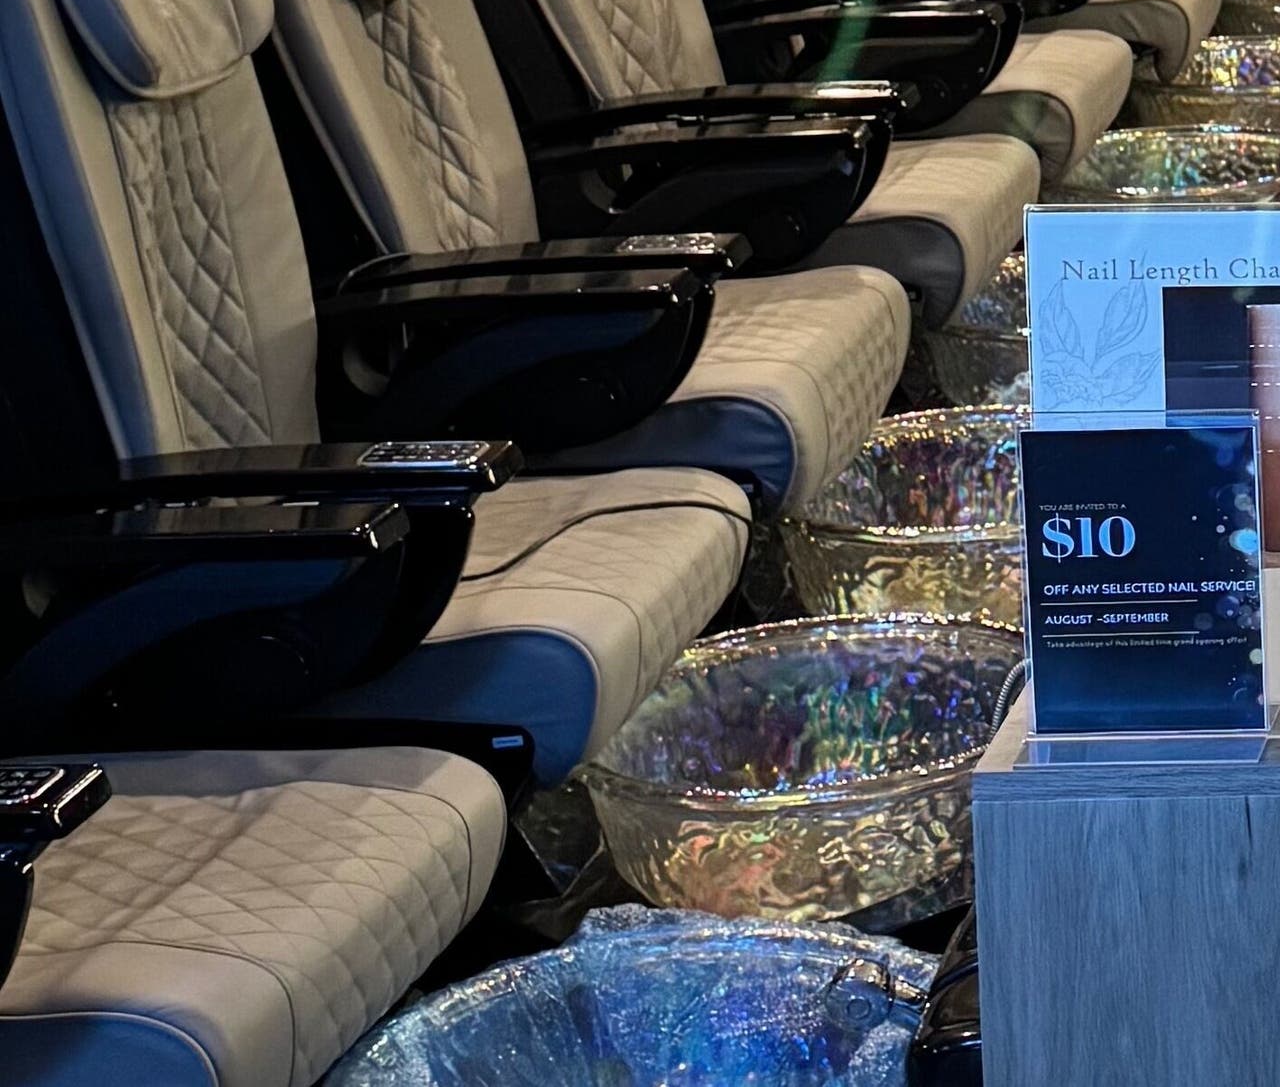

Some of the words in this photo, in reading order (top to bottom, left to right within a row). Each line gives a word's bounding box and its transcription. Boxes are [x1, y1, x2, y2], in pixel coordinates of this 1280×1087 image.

[1062, 258, 1118, 281] Nail
[1129, 258, 1219, 285] Length
[1042, 512, 1136, 563] $10
[1043, 584, 1069, 596] OFF
[1071, 583, 1099, 595] ANY
[1101, 582, 1165, 595] SELECTED
[1168, 581, 1198, 593] NAIL
[1045, 614, 1092, 625] AUGUST
